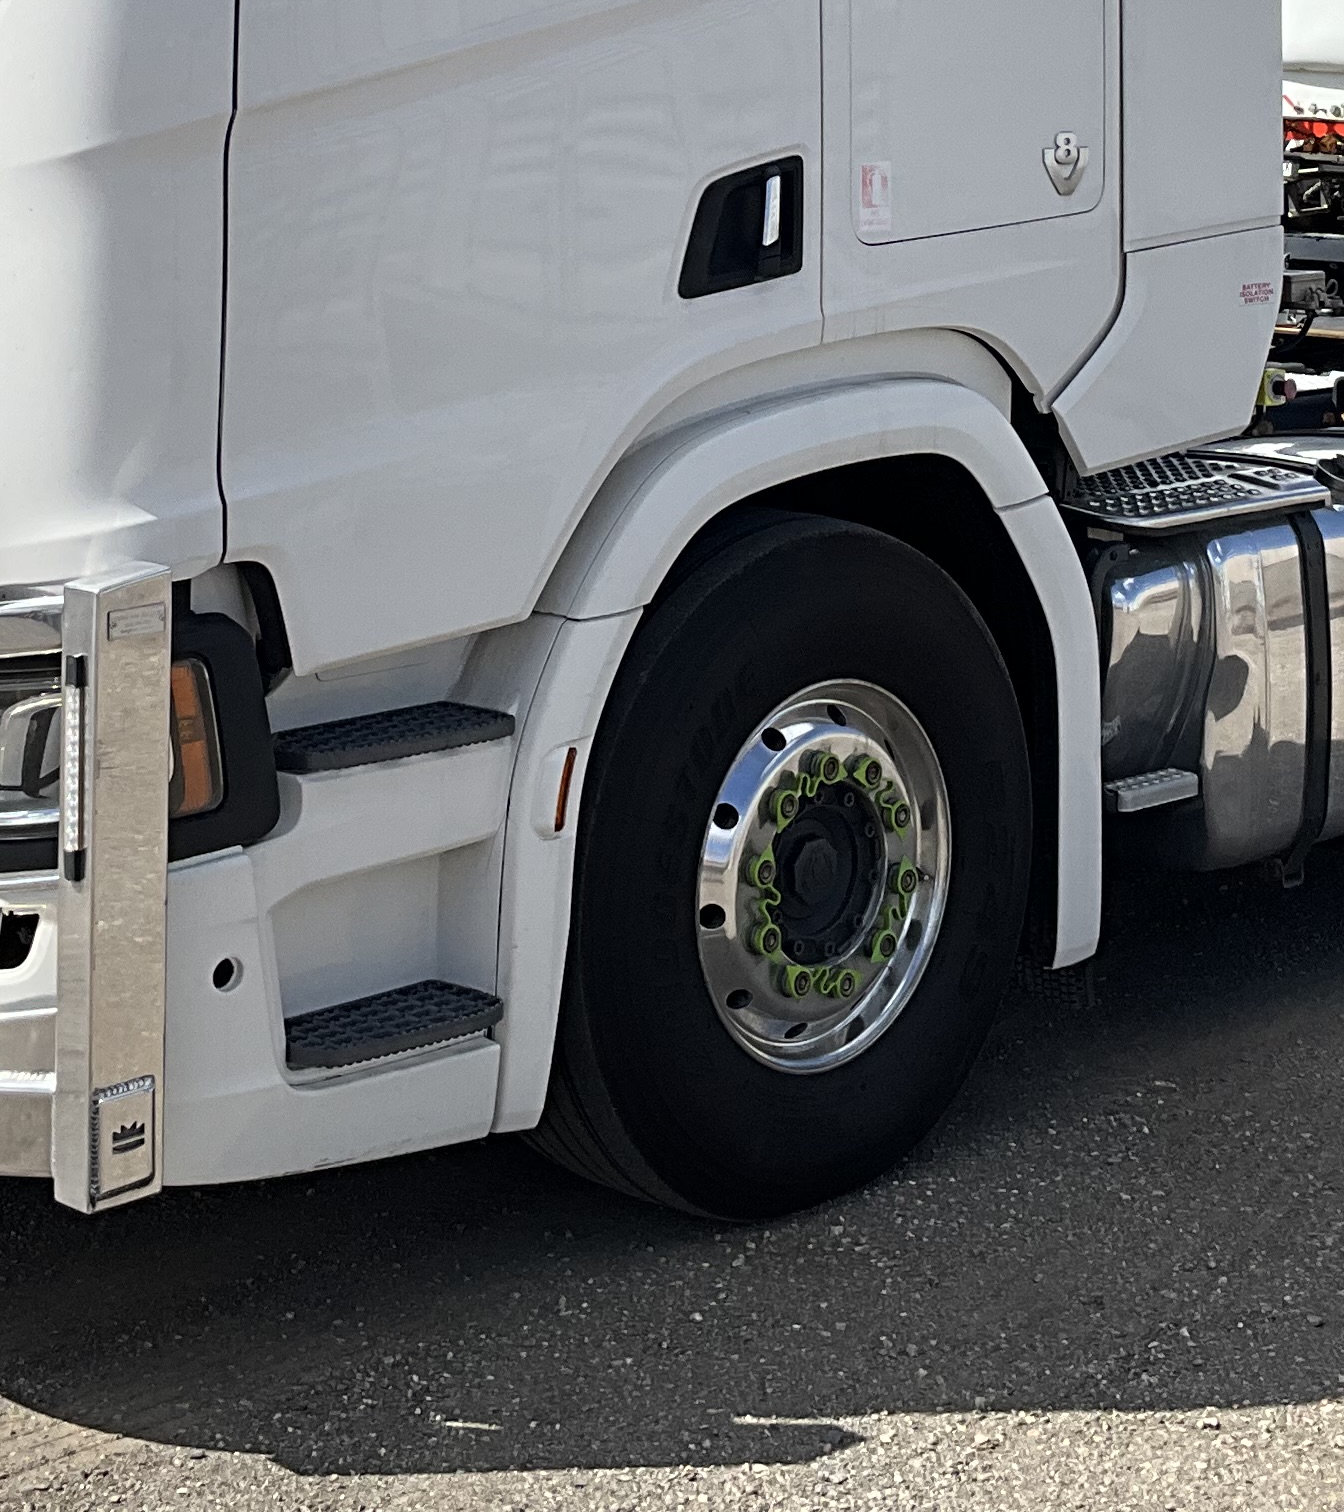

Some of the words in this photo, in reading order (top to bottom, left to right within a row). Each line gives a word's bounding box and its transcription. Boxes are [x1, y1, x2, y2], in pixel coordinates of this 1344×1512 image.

[1242, 282, 1271, 291] BATTERY
[1239, 288, 1274, 298] ISOLATION
[1244, 295, 1270, 304] SWITCH
